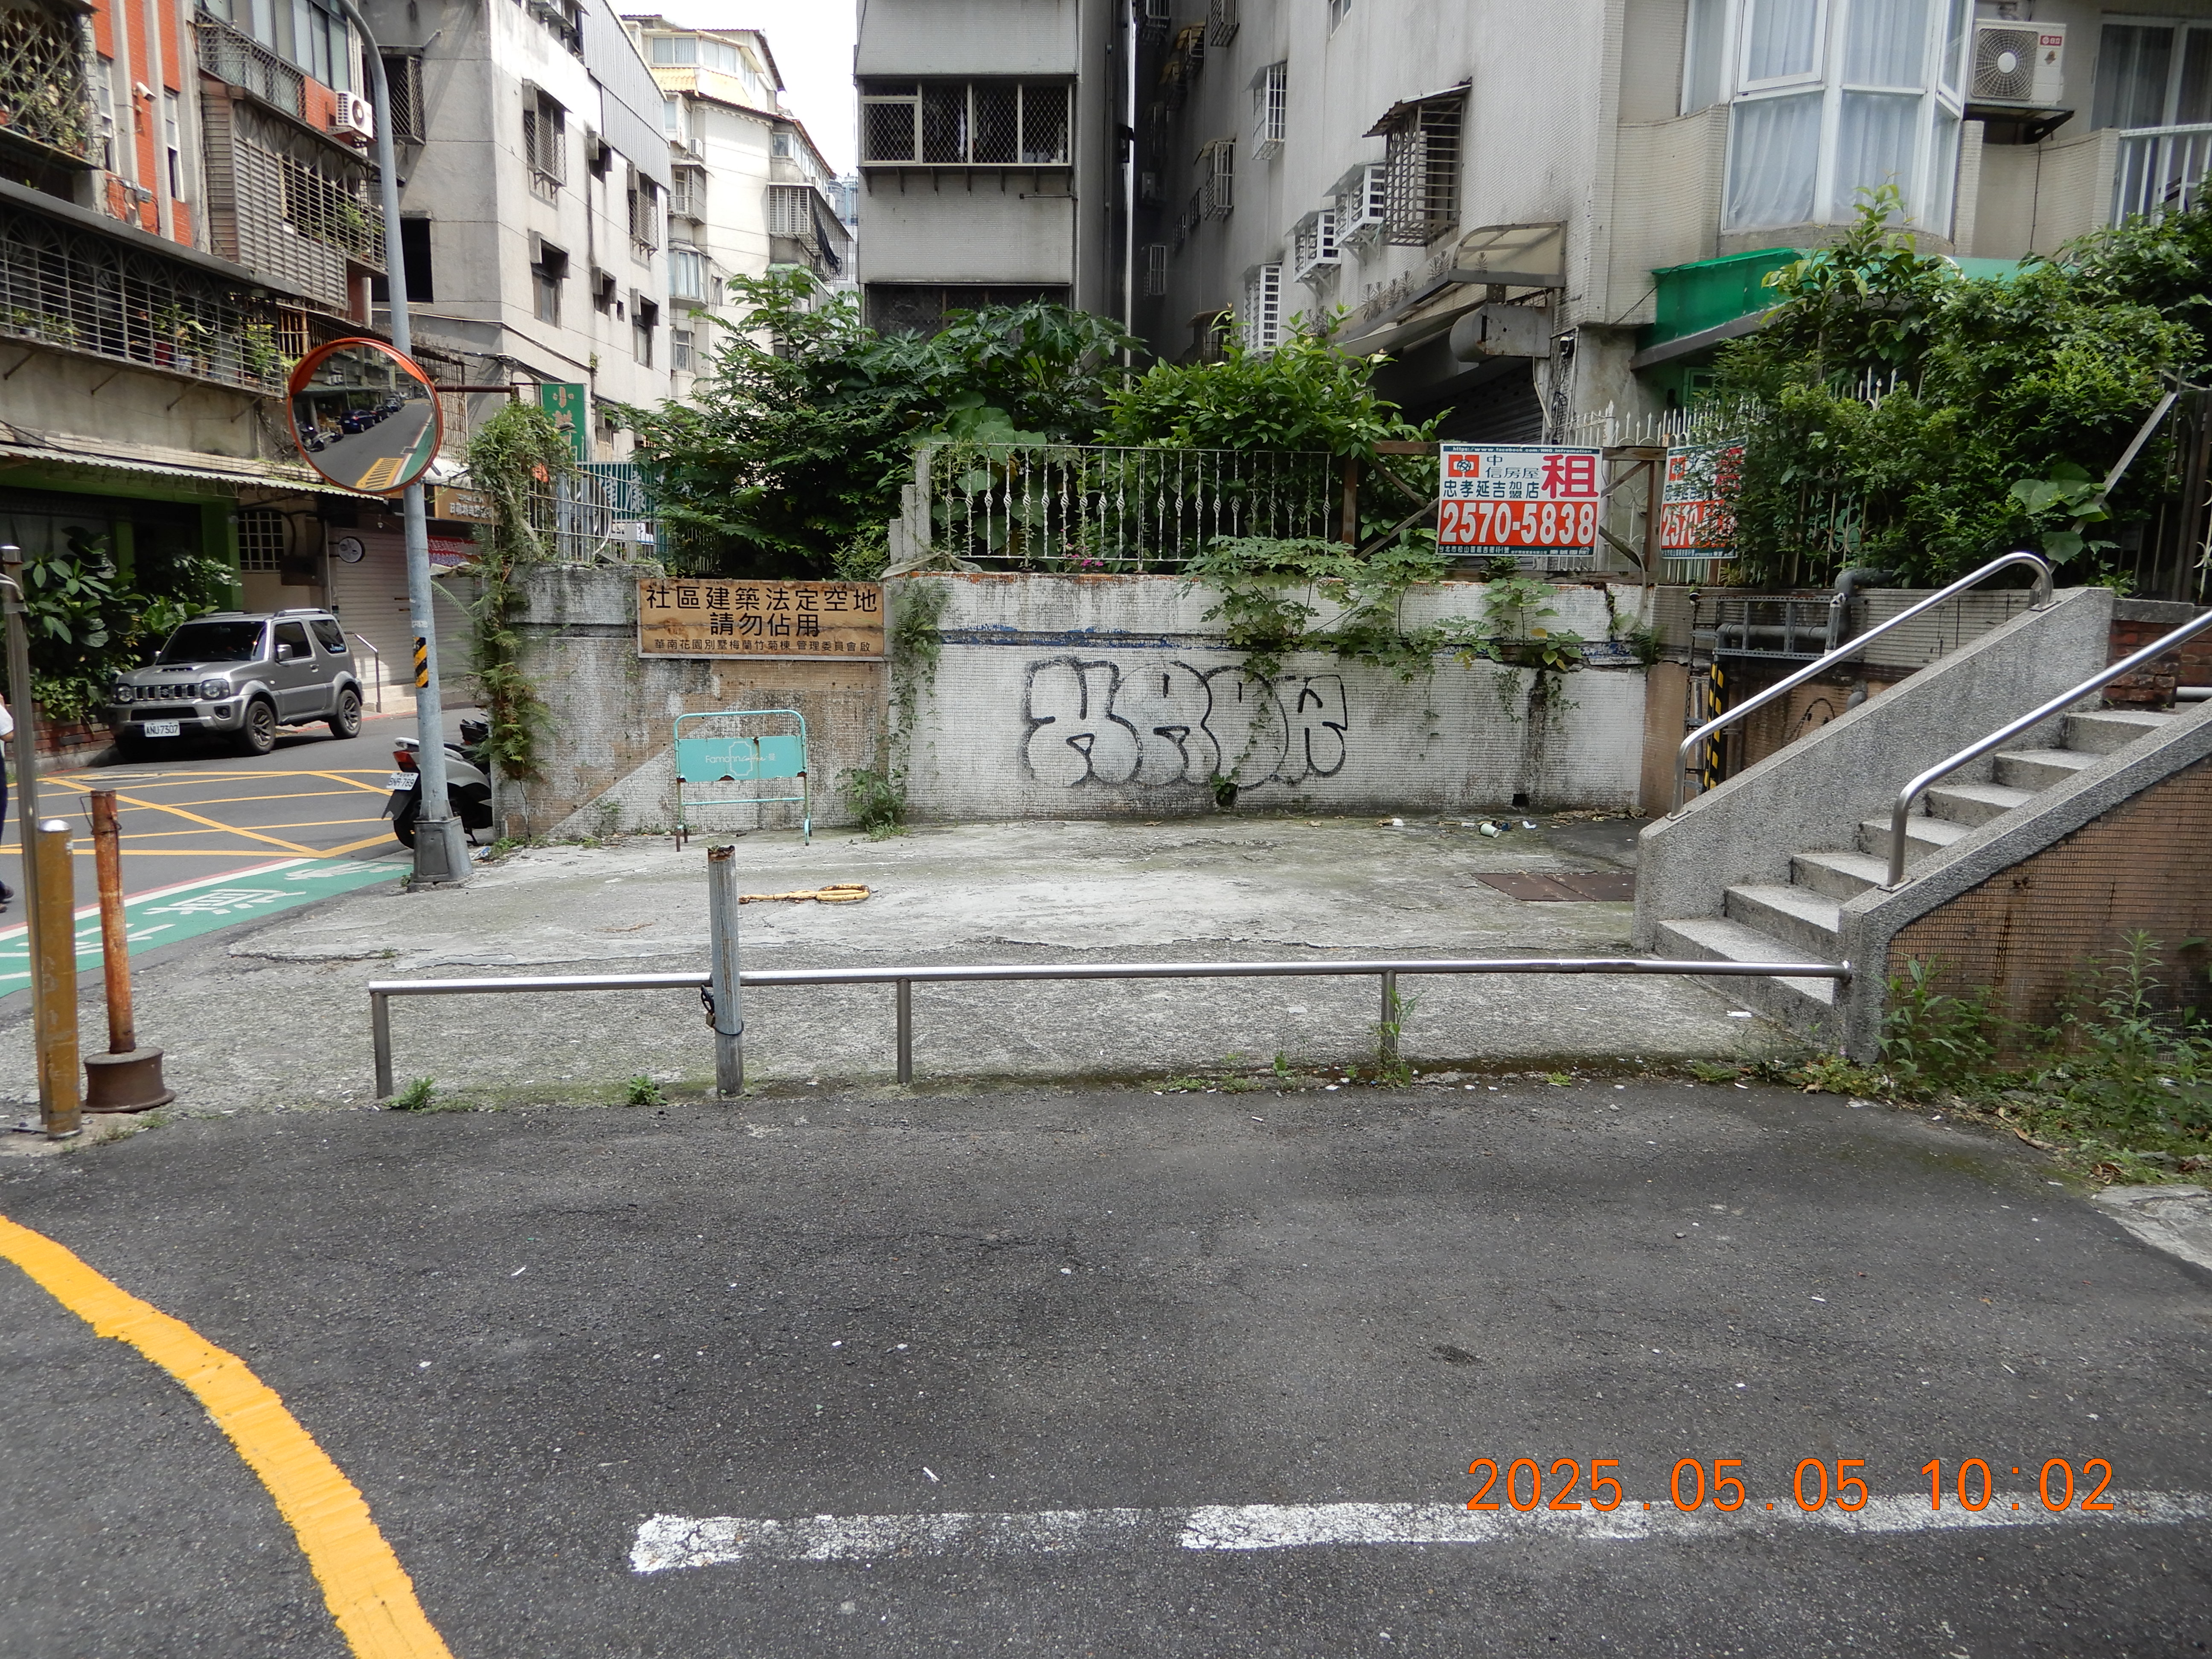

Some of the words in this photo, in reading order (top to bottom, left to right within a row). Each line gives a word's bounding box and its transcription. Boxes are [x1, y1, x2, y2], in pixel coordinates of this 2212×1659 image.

[1485, 466, 1540, 479] 信房屋
[1541, 454, 1599, 499] 租
[1441, 502, 1594, 545] 2570-5838
[646, 585, 878, 613] 社區建築法定空地
[710, 612, 820, 637] 請勿佔用
[655, 639, 792, 651] 華南花園別墅梅蘭竹菊棟
